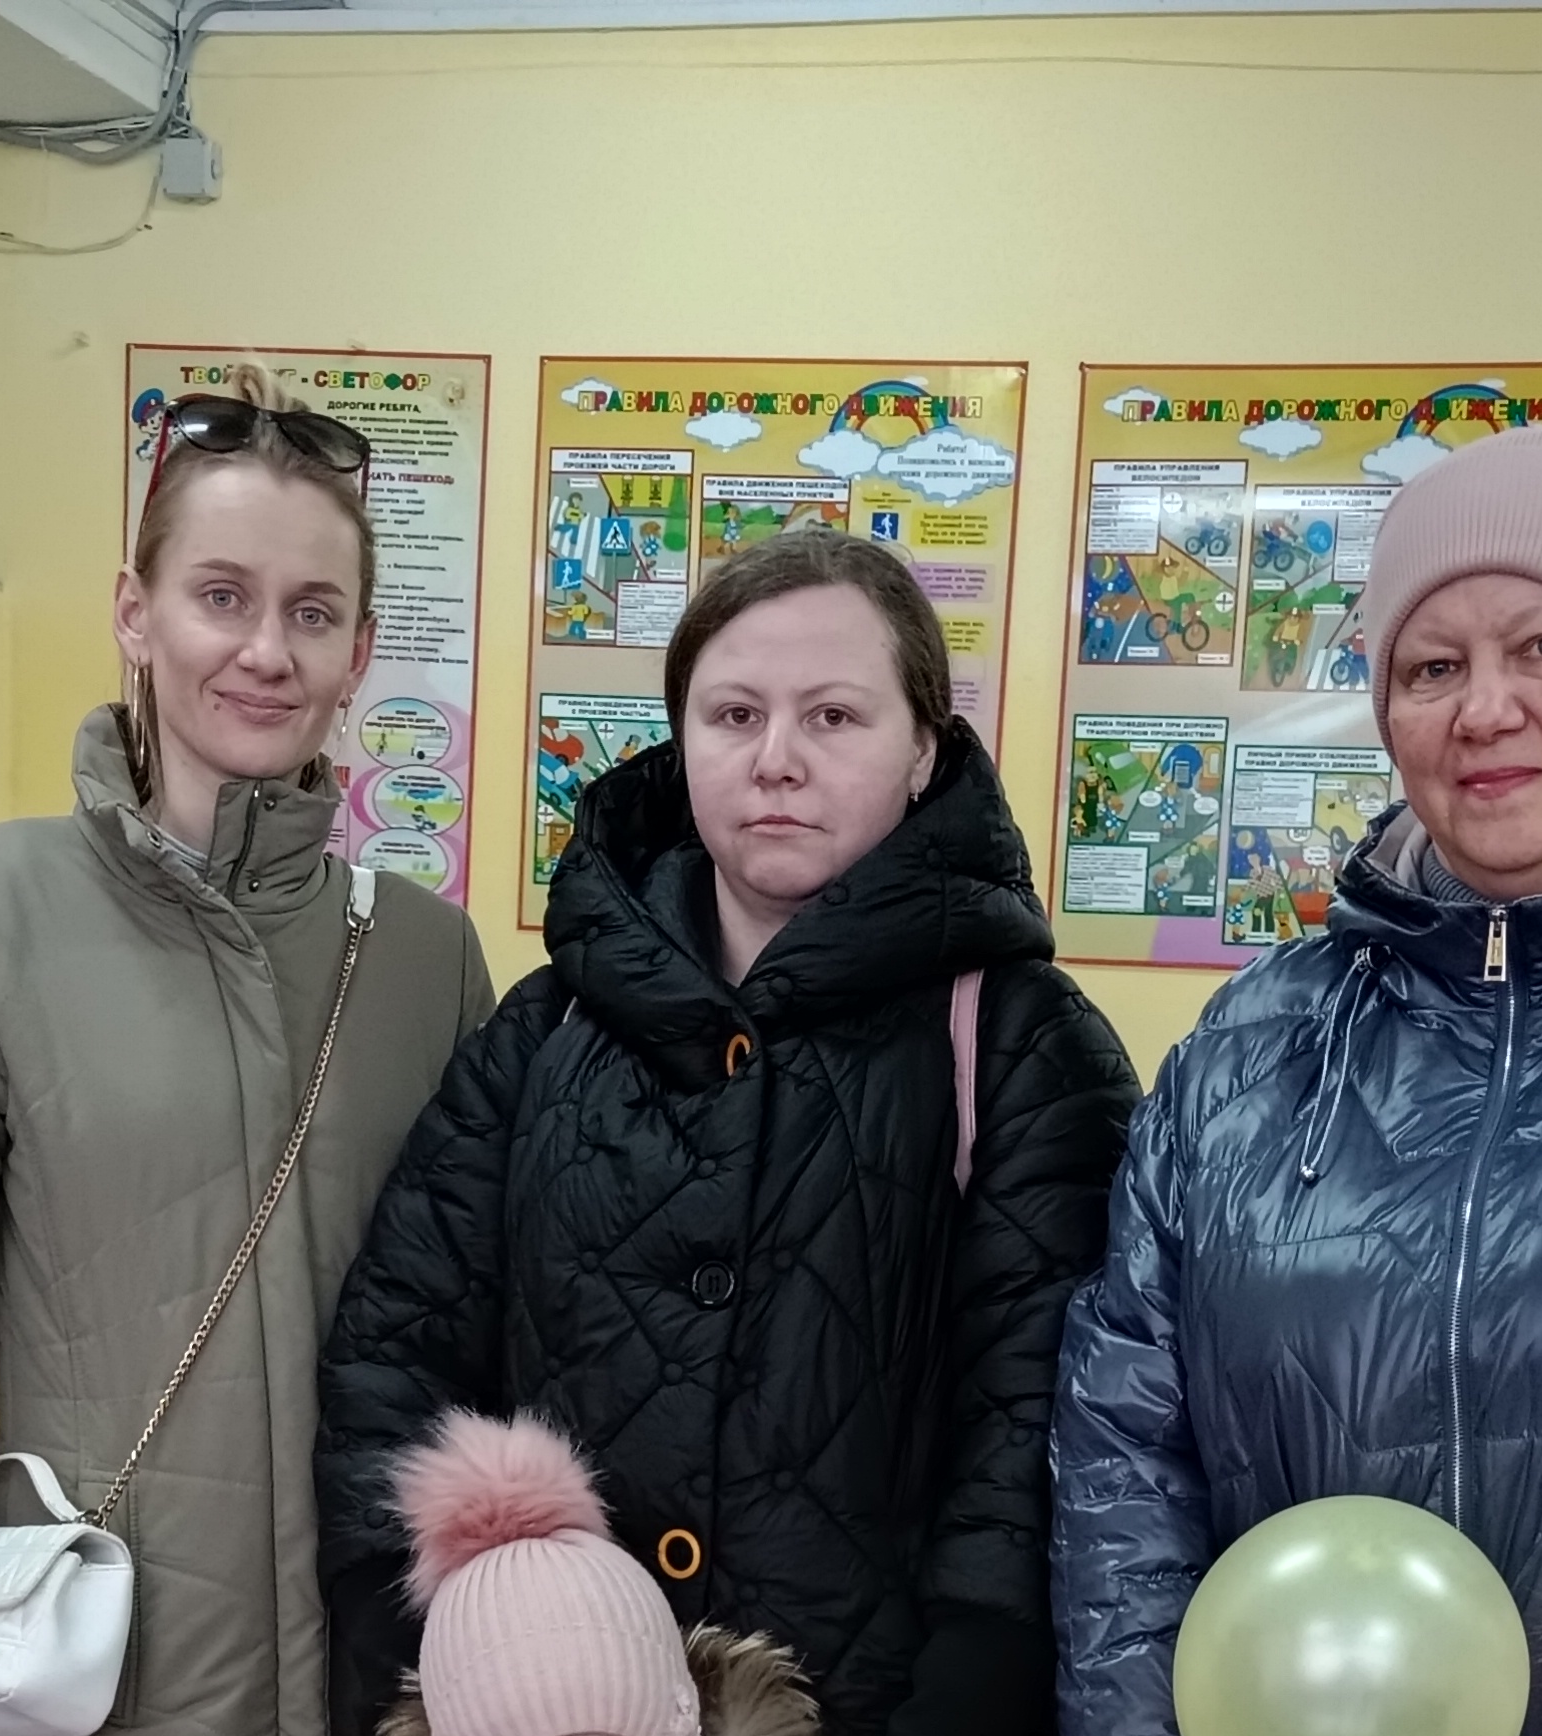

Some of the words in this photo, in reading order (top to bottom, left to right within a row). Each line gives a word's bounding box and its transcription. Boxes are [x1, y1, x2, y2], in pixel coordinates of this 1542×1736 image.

[313, 370, 431, 392] СВЕТОФОР
[327, 400, 376, 411] ДОРОГИЕ
[379, 402, 422, 414] РЕБЯТА,
[577, 390, 684, 414] ПРАВИЛА
[688, 391, 839, 418] ДОРОЖНОГО
[844, 393, 983, 420] ДВИЖЕНИЯ
[1121, 399, 1239, 422] ПРАВИЛА
[1244, 399, 1409, 425] ДОРОЖНОГО
[568, 452, 607, 460] ПРАВИЛА
[609, 452, 671, 461] ПЕРЕСЕЧЕНИЯ
[563, 461, 609, 470] ПРОЕЗЖЕЙ
[641, 463, 676, 471] ДОРОГИ
[1131, 474, 1201, 482] ВЕЛОСИПЕДОМ
[705, 479, 744, 487] ПРАВИЛА
[746, 480, 794, 488] ДВИЖЕНИЯ
[795, 481, 848, 490] ПЕШЕХОДОВ
[737, 490, 794, 498] НАСЕЛЕННЫХ
[796, 491, 834, 499] ПУНКТОВ
[593, 701, 638, 709] ПОВЕДЕНИЯ
[1278, 760, 1330, 768] ДОРОЖНОГО
[1332, 761, 1378, 769] ДВИЖЕНИЯ
